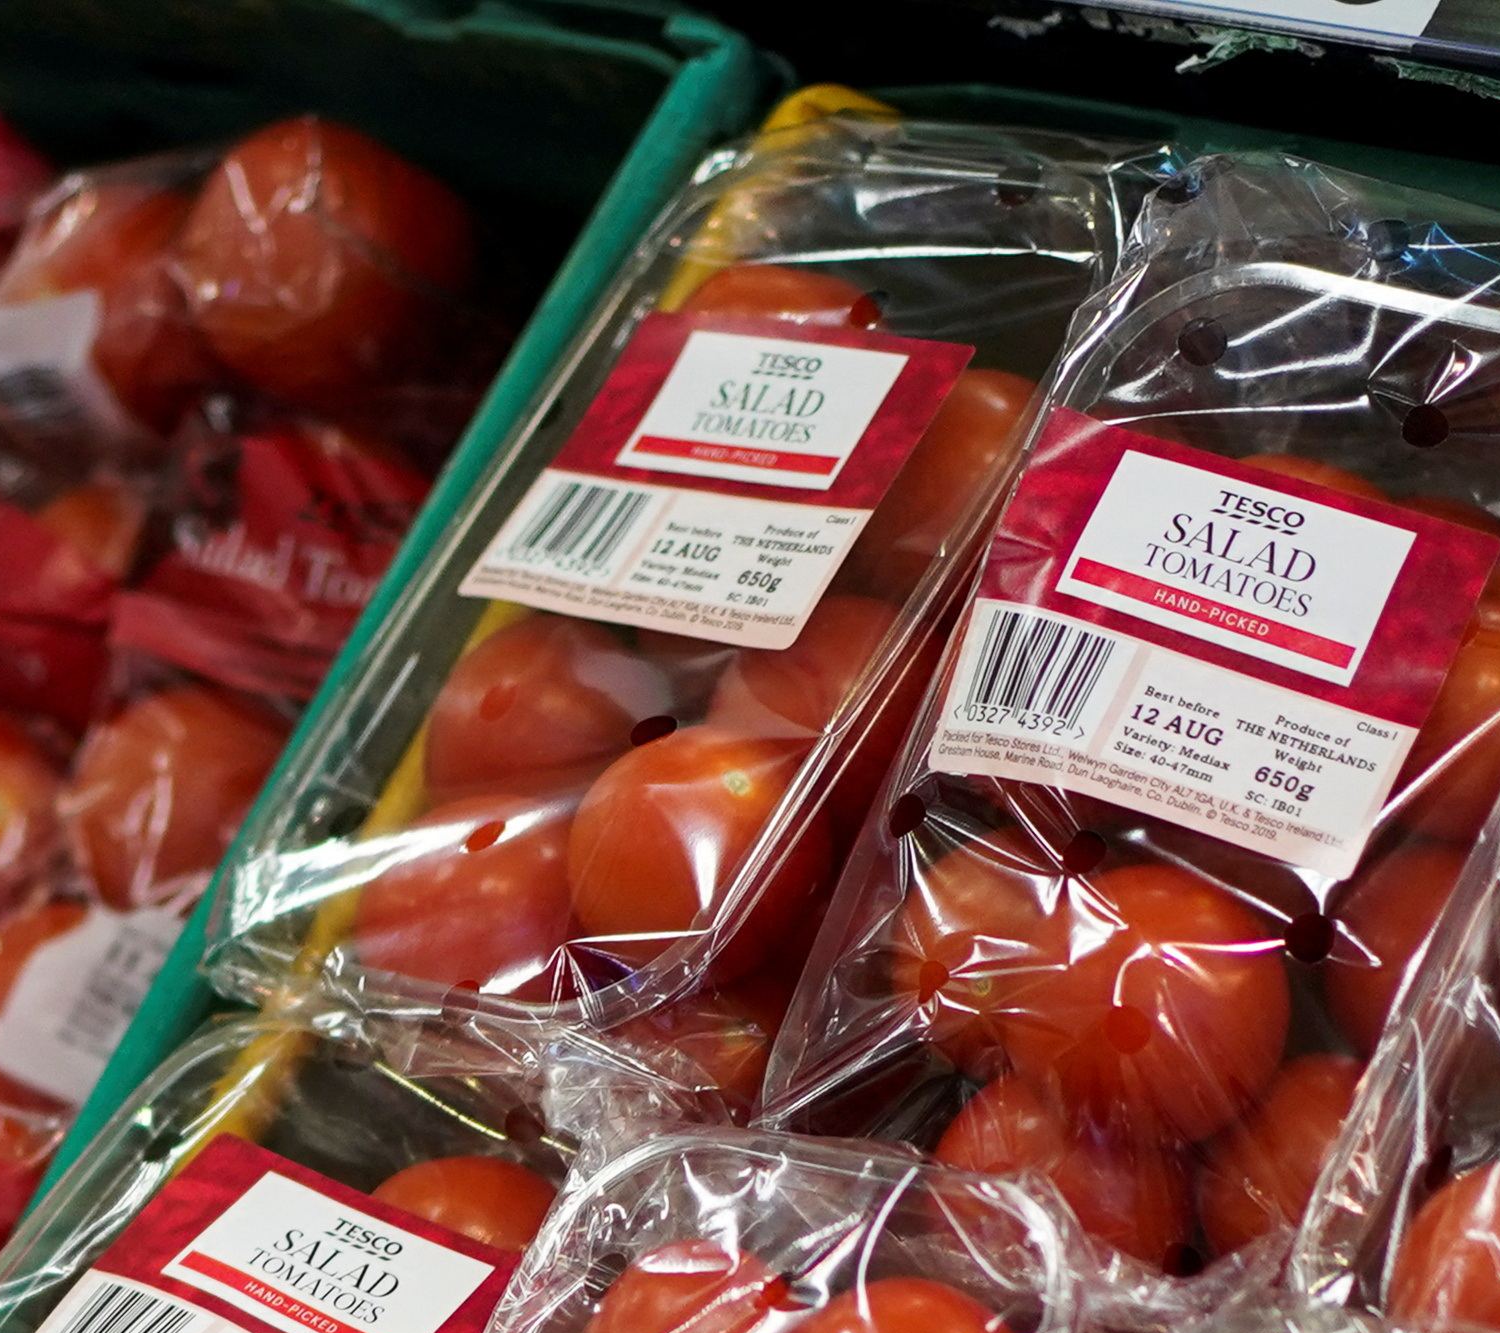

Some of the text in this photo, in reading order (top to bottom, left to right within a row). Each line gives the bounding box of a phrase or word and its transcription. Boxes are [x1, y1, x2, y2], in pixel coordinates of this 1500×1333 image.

[754, 352, 823, 373] TESCO
[709, 380, 825, 418] SALAD
[690, 412, 817, 444] TOMATOES
[825, 515, 850, 525] Class
[1219, 490, 1305, 529] TESCO
[650, 539, 722, 562] 12 AUG
[757, 554, 793, 567] Weight
[1162, 512, 1317, 585] SALAD
[737, 569, 782, 593] 650g
[1144, 542, 1313, 618] TOMATOES
[1153, 587, 1271, 637] HAND-PICKED
[1144, 685, 1220, 719] Best before
[1131, 704, 1224, 747] 12 AUG
[1275, 715, 1351, 749] Produce of
[1356, 721, 1389, 740] Class
[1114, 740, 1213, 783] Size: 40-47mm
[1122, 726, 1231, 771] Variety: Mediax
[1236, 719, 1377, 773] THE NETHERLANDS
[1274, 749, 1323, 774] Weight
[942, 729, 969, 743] Packed
[971, 732, 983, 743] for
[985, 734, 1009, 748] Tesco
[1011, 737, 1041, 753] Stores
[1068, 750, 1107, 770] Welwyn
[1109, 764, 1148, 784] Garden
[1149, 778, 1170, 793] City
[1253, 810, 1284, 829] Tesco
[1286, 821, 1322, 842] Ireland
[1005, 751, 1036, 766] Marine
[1067, 764, 1088, 777] Dun
[1219, 811, 1250, 832] Tesco
[1244, 790, 1267, 806] SC:
[1253, 766, 1315, 802] 650g
[333, 1217, 403, 1257] TESCO
[271, 1228, 400, 1301] SALAD
[246, 1246, 386, 1326] TOMATOES
